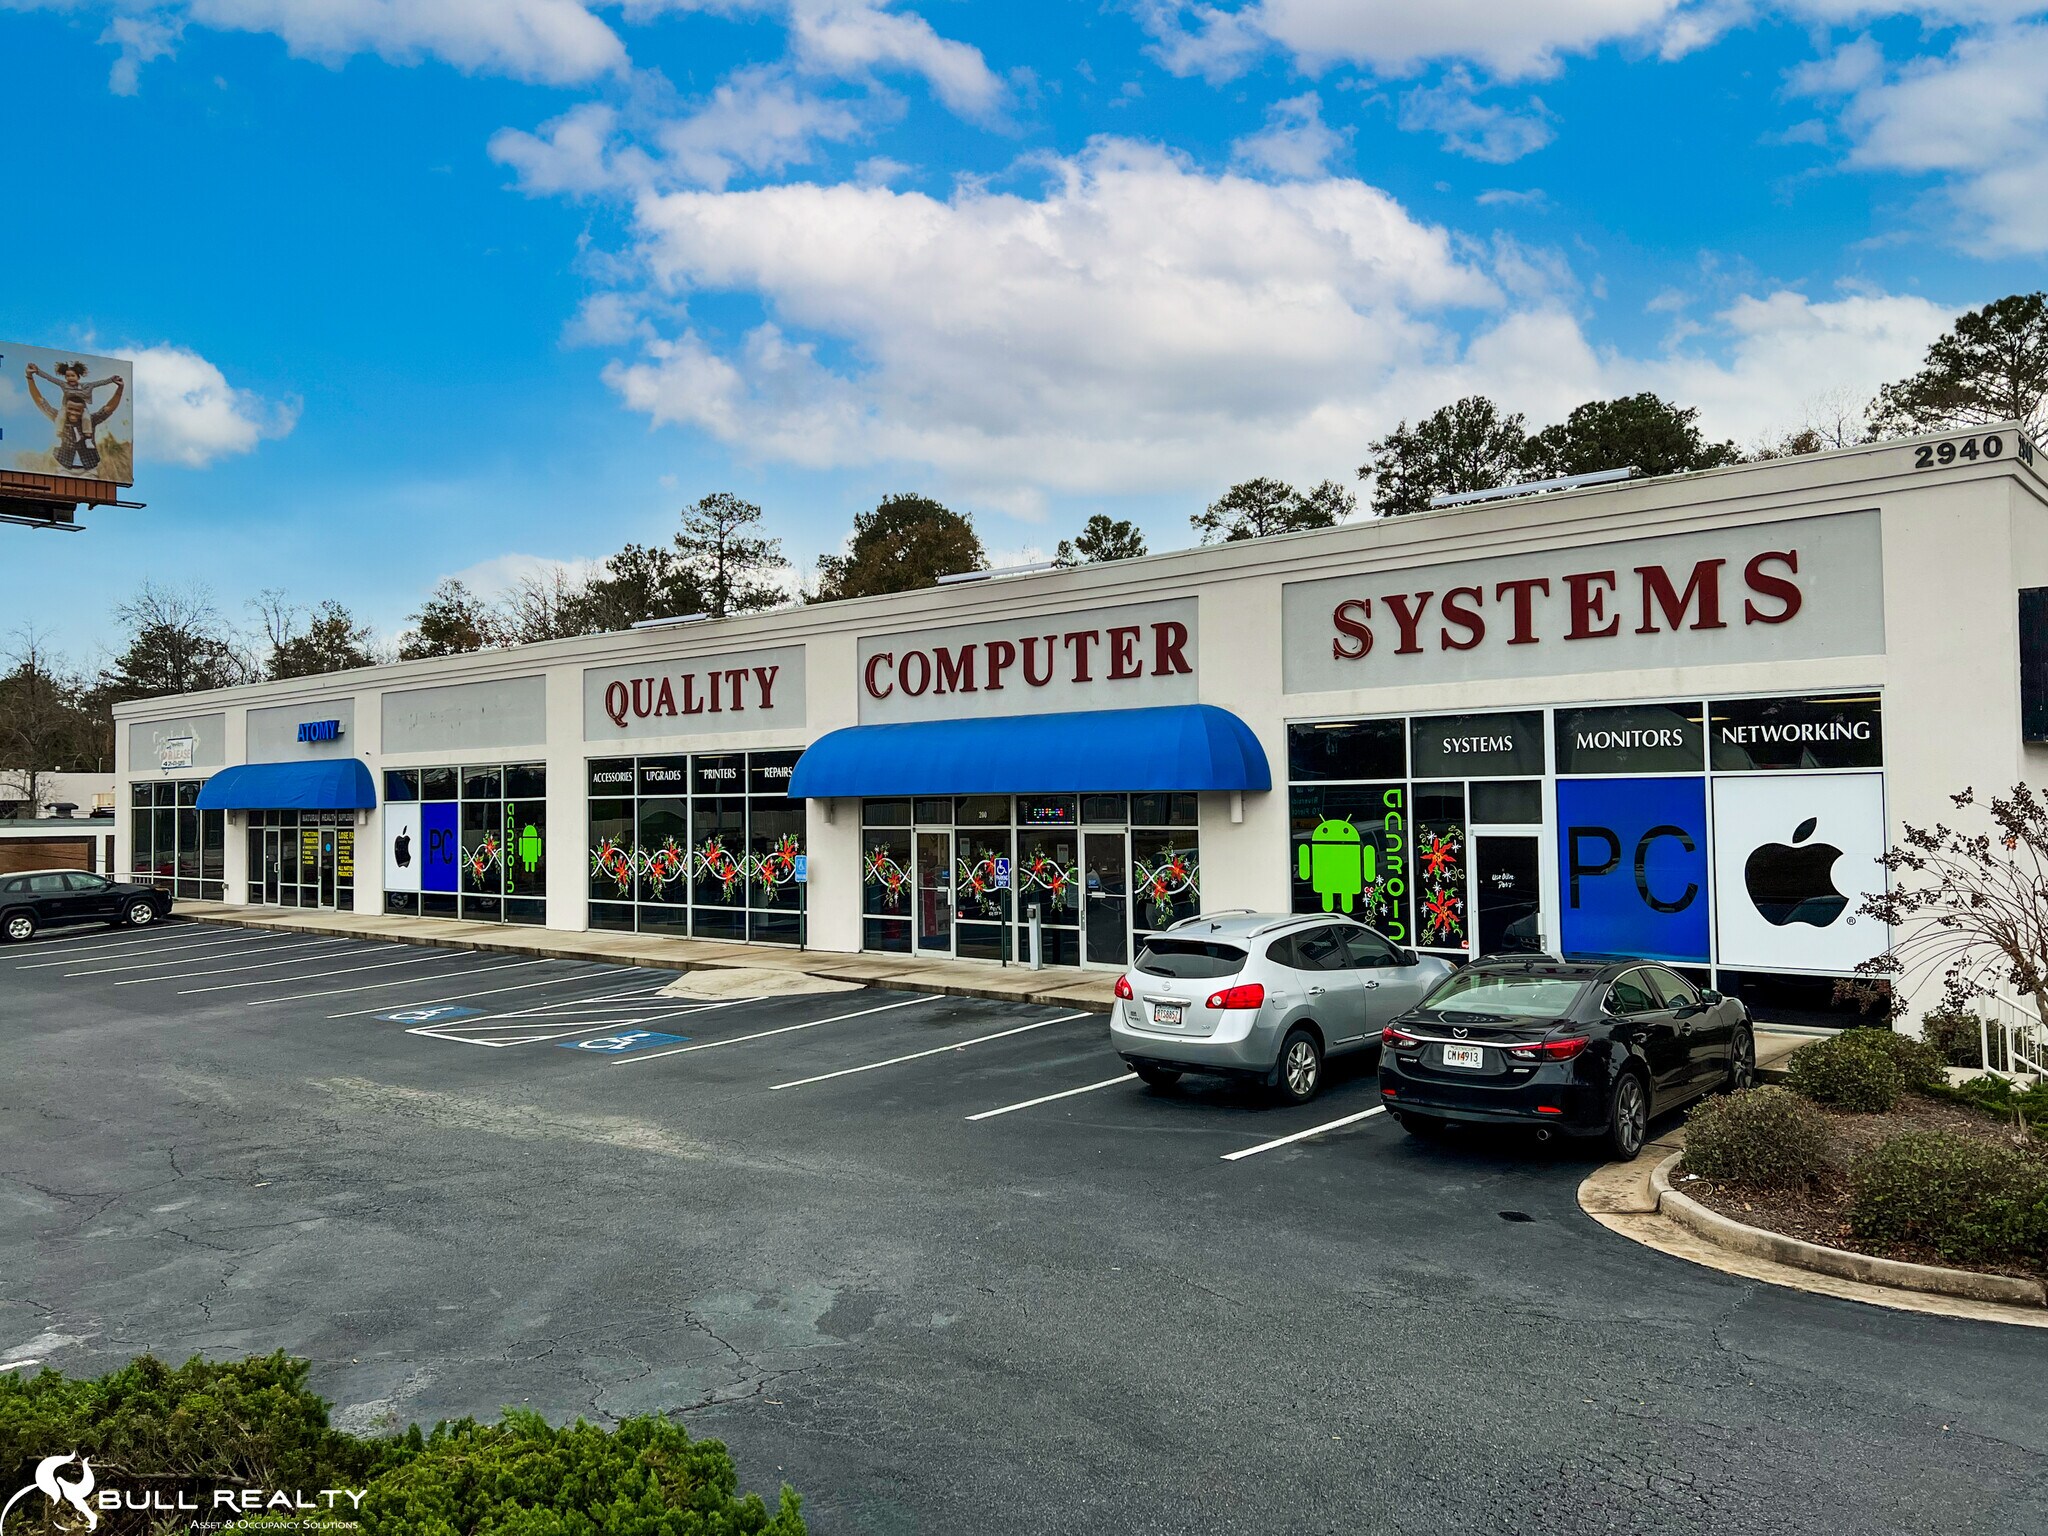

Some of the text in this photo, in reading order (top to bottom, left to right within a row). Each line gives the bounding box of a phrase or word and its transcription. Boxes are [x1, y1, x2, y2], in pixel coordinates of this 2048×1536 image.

[1914, 435, 2003, 469] 2940
[605, 549, 1803, 728] QUALITY COMPUTER SYSTEMS
[297, 720, 339, 742] ATOMY
[1576, 728, 1683, 749] MONITORS
[1722, 721, 1871, 744] NETWORKING
[1442, 735, 1513, 754] SYSTEMS
[593, 771, 633, 782] ACCESSORIES
[646, 770, 682, 781] UPGRADES
[703, 768, 737, 779] PRINTERS
[764, 766, 793, 778] REPAIRS
[429, 828, 453, 864] PC
[1568, 824, 1699, 914] PC
